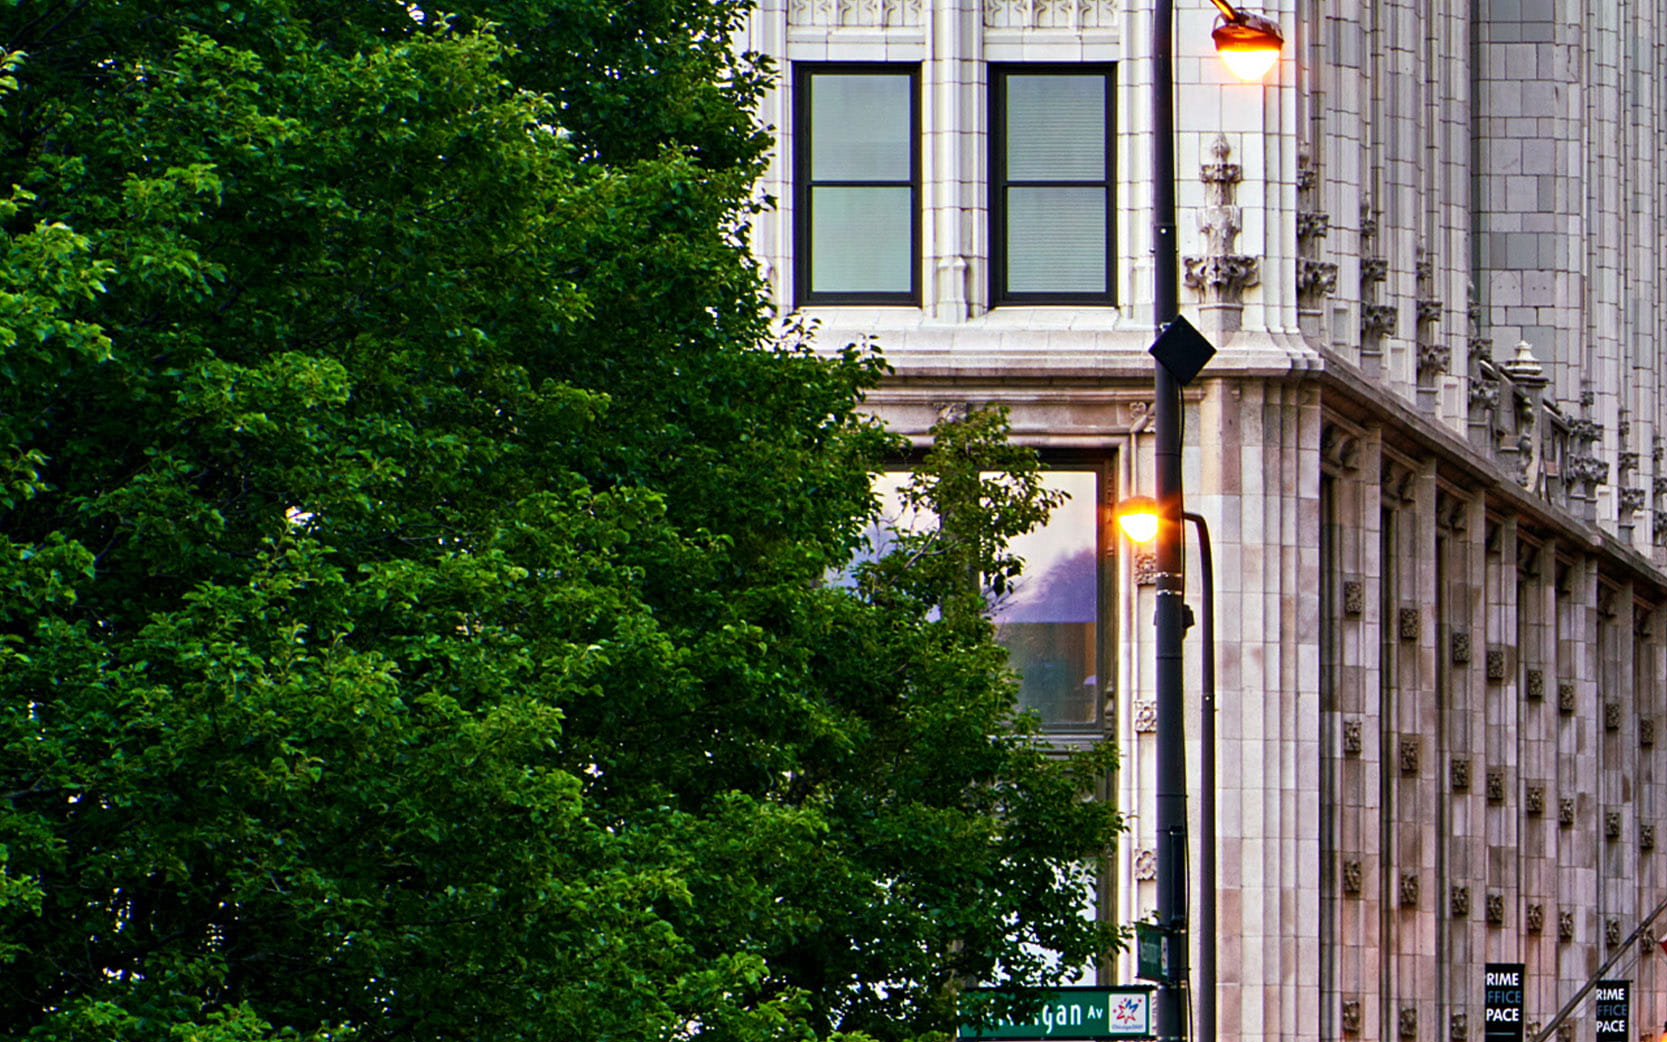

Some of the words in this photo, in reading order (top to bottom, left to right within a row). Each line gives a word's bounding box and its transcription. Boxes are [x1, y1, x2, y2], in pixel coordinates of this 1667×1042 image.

[1486, 972, 1519, 986] RIME
[1487, 991, 1521, 1004] FFICE
[1596, 988, 1625, 1000] RIME
[1087, 1005, 1103, 1019] Av
[1486, 1008, 1519, 1022] PACE
[1597, 1005, 1628, 1017] FFICE
[1596, 1020, 1625, 1032] PACE
